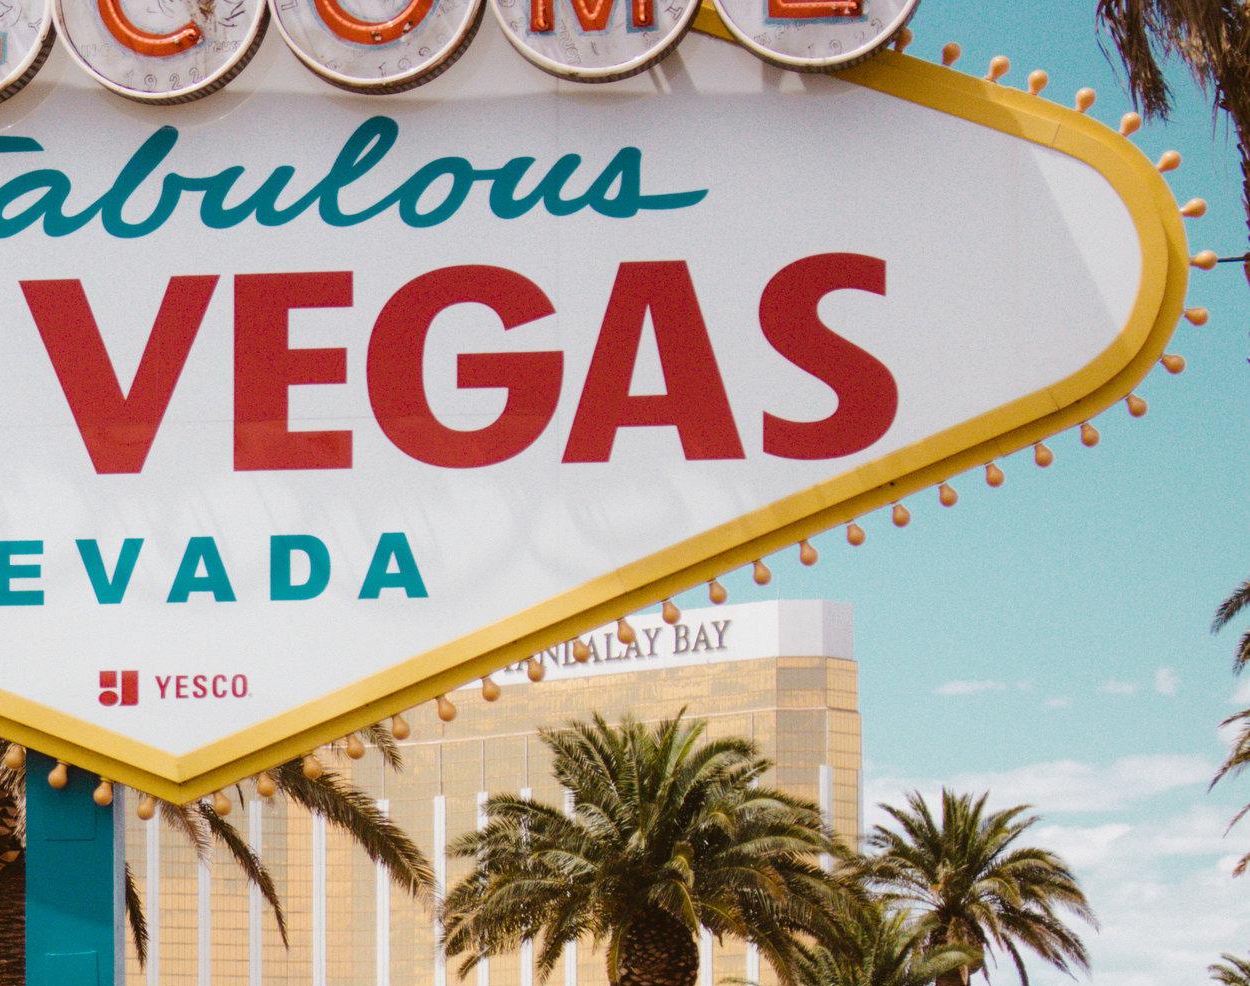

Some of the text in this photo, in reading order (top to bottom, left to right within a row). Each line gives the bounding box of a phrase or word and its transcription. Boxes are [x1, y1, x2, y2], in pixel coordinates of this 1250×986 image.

[19, 252, 898, 474] VEGAS
[673, 620, 732, 655] BAY
[155, 674, 248, 699] YESCO
